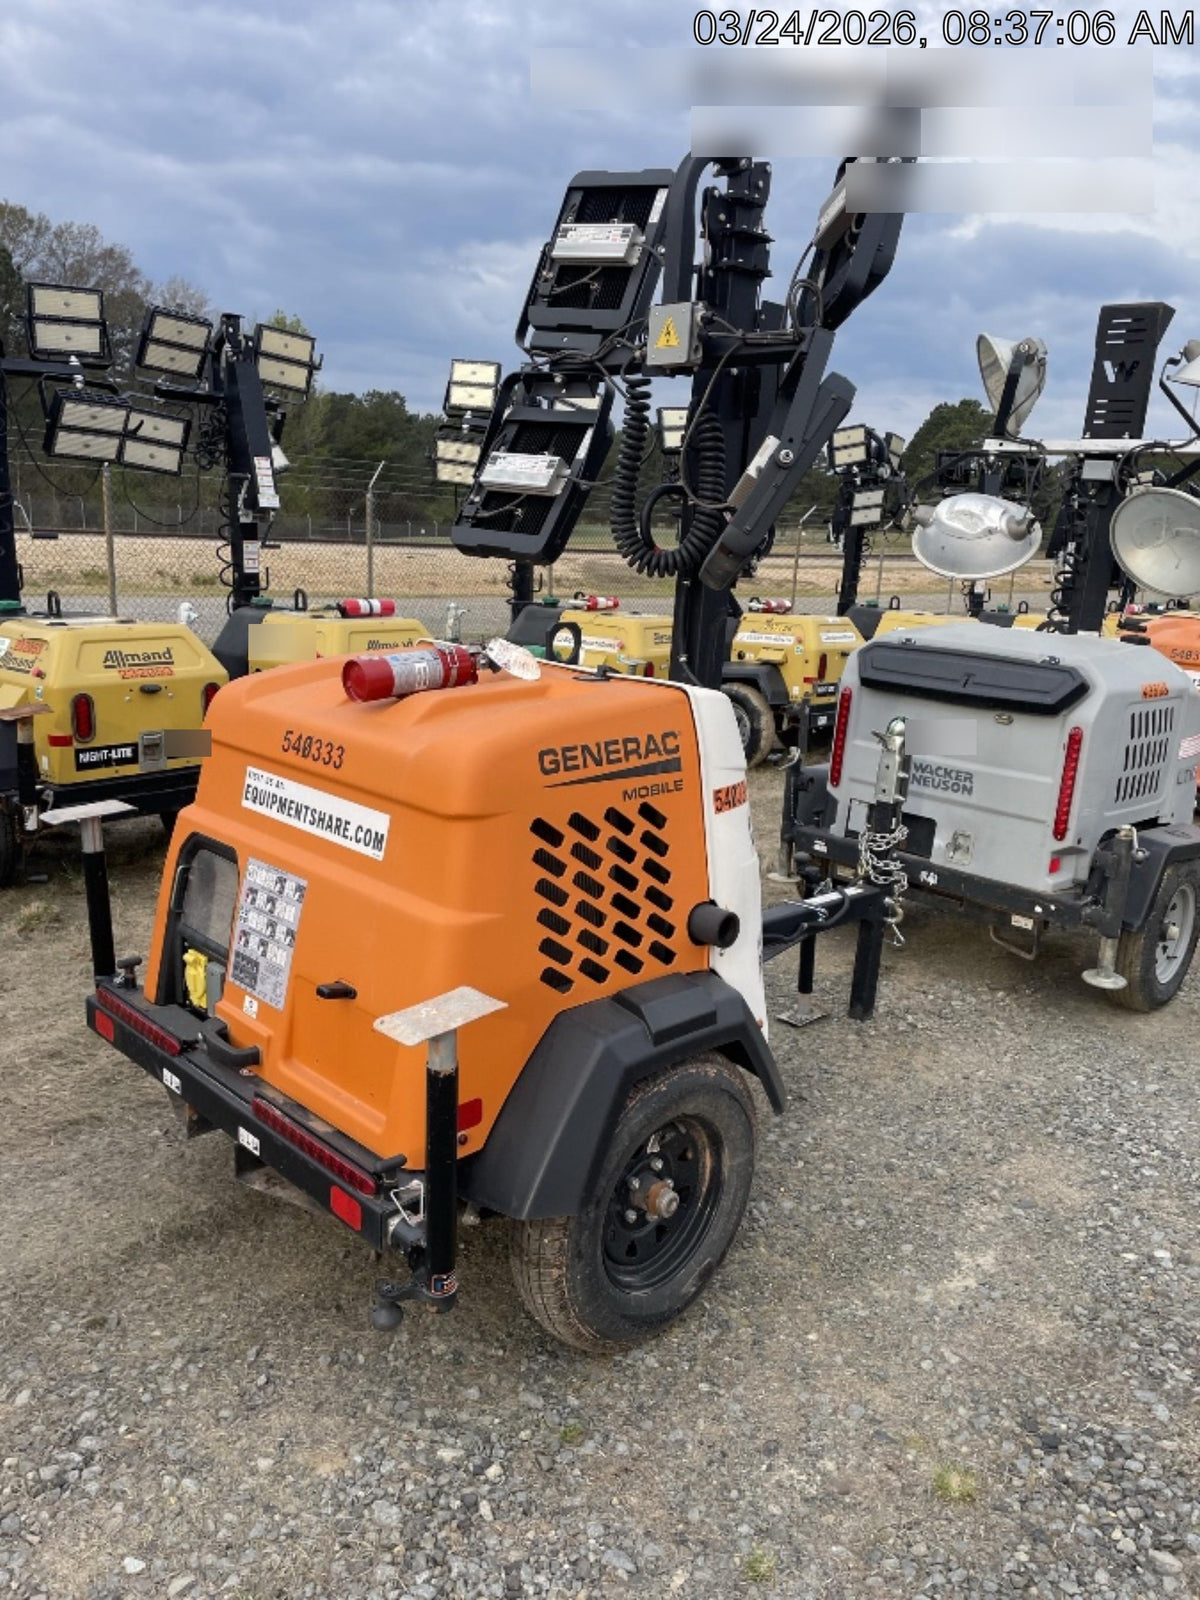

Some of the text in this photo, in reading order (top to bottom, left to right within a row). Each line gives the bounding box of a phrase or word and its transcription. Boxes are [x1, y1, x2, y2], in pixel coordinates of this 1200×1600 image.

[102, 647, 173, 668] Allmand
[281, 730, 345, 769] 540333
[538, 731, 680, 775] GENERAC
[911, 773, 974, 796] NEUSON
[913, 762, 974, 784] WACKER
[623, 779, 683, 802] MOBILE
[244, 784, 385, 852] EQUIPMENTSHARE.COM
